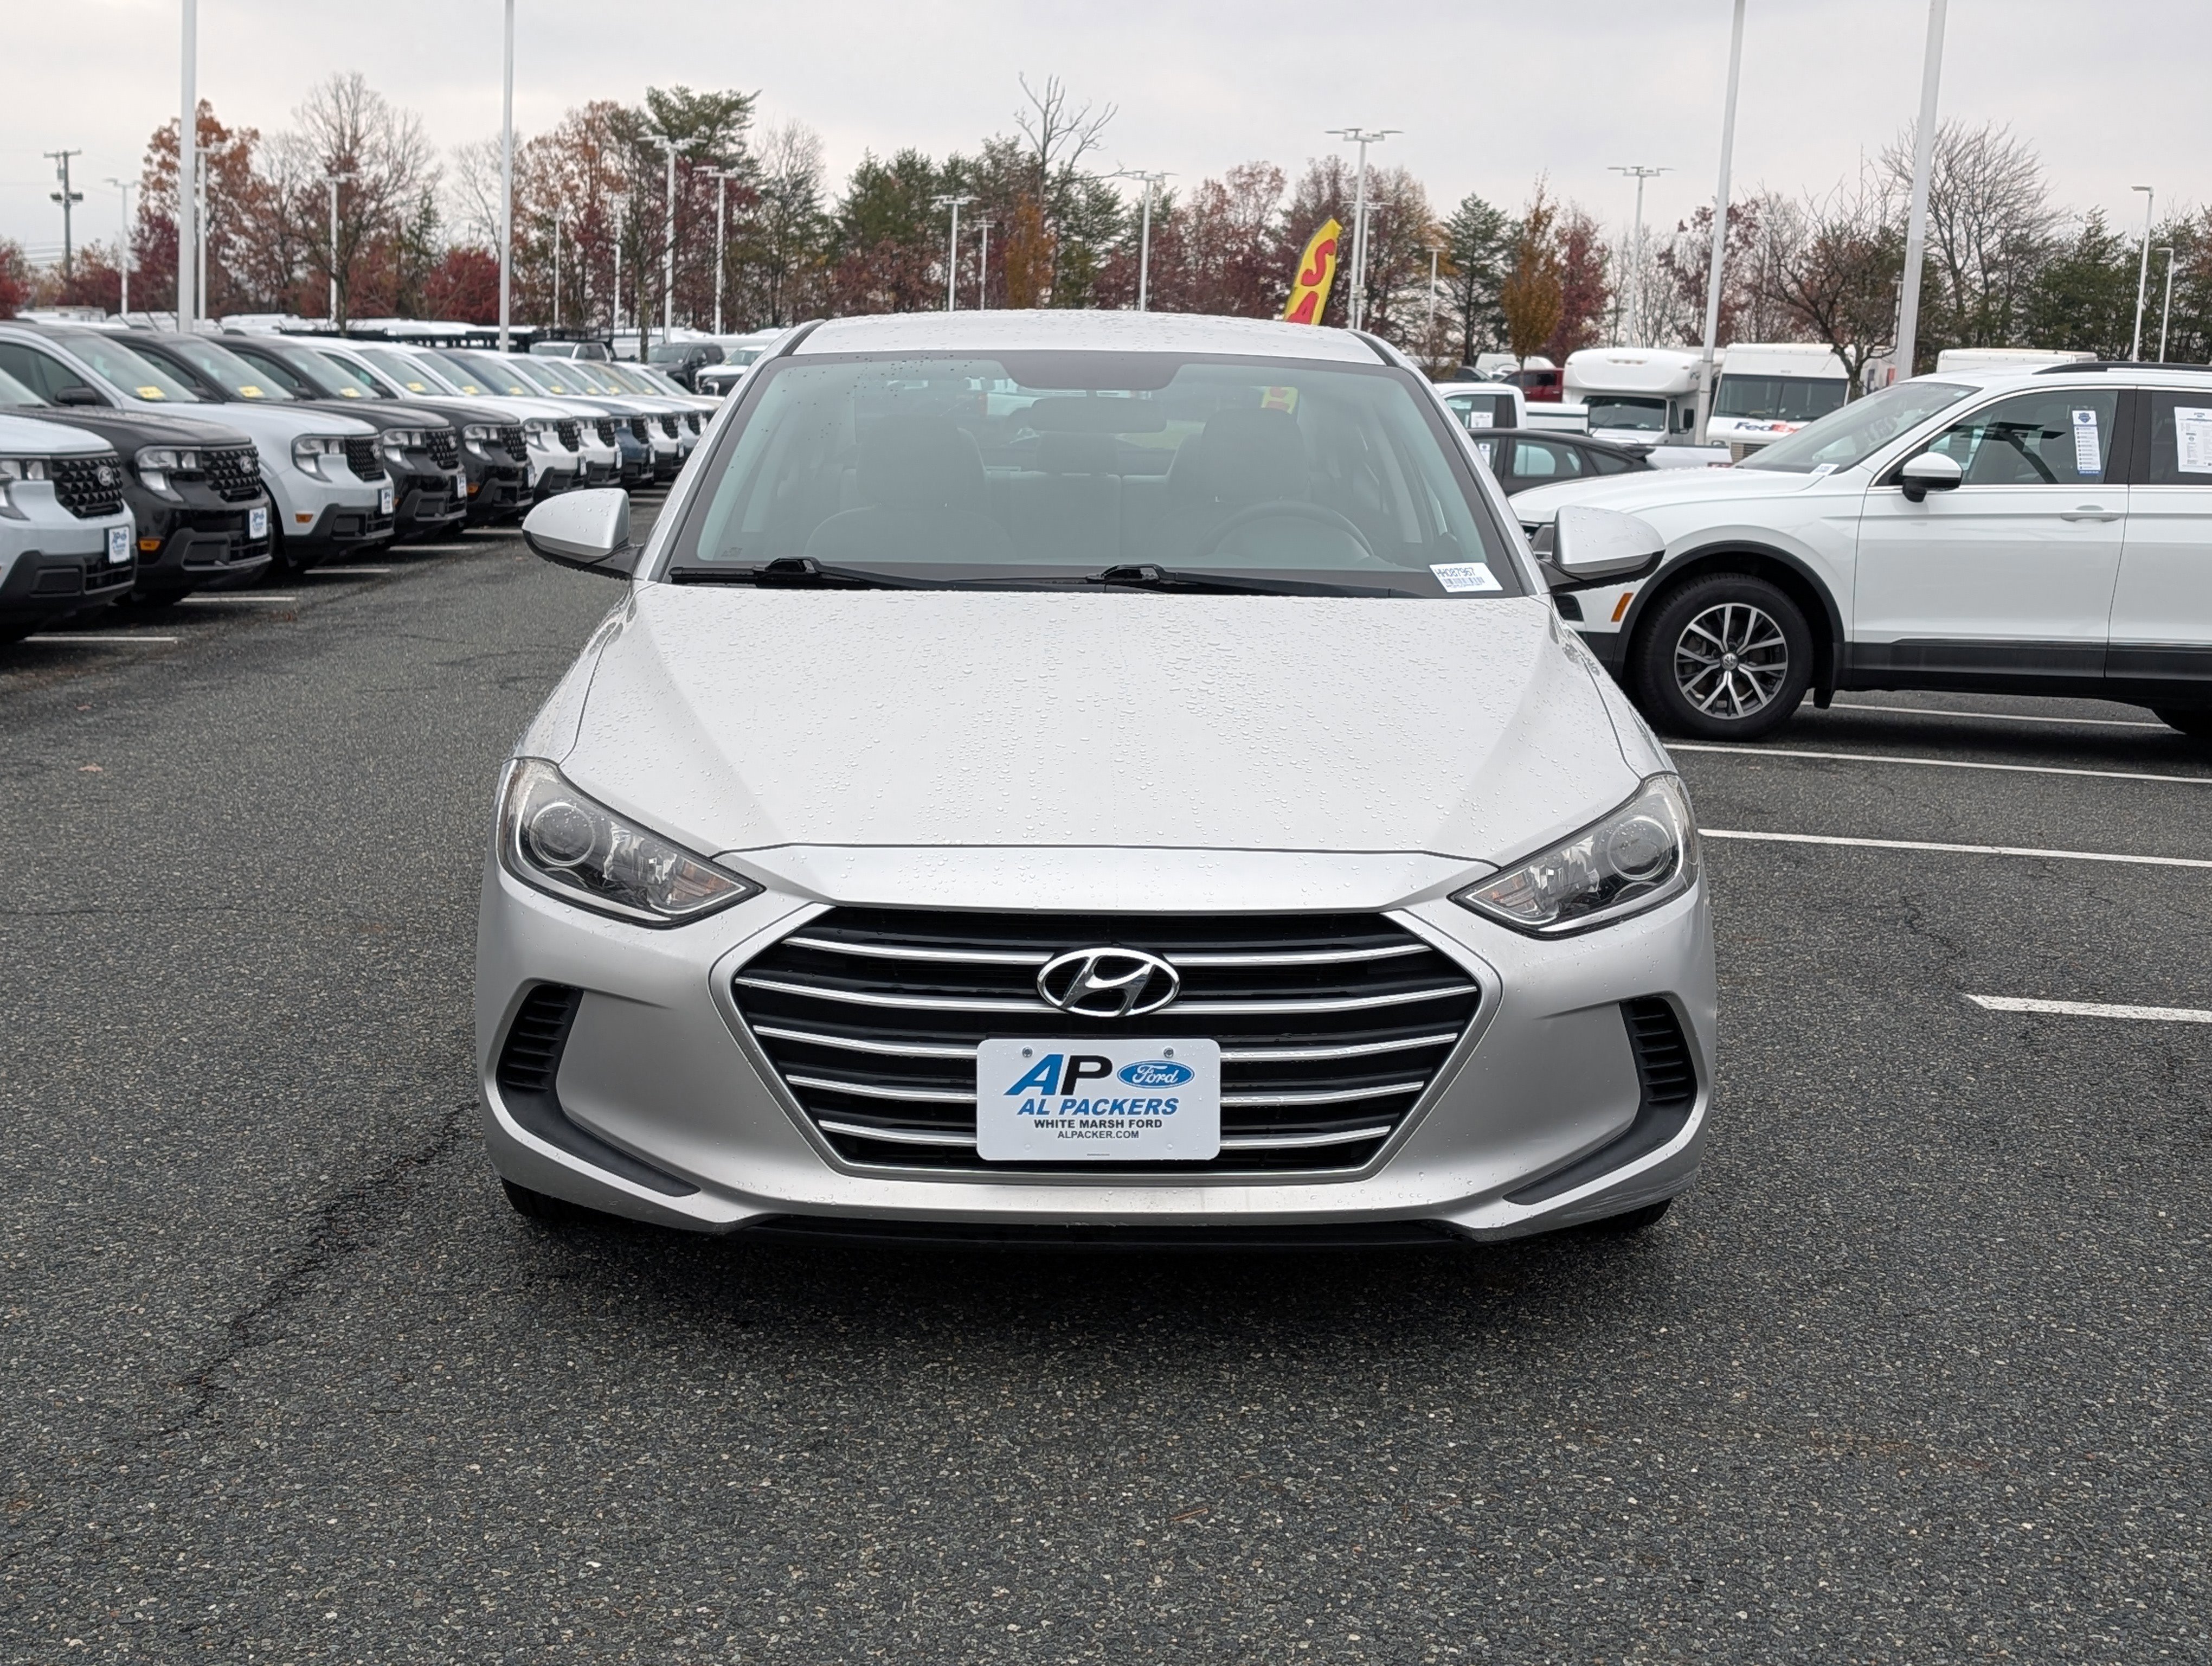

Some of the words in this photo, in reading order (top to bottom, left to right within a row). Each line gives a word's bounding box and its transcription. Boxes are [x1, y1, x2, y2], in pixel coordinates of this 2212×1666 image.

[1003, 1054, 1113, 1096] AP
[1132, 1065, 1180, 1084] Ford
[1017, 1098, 1051, 1116] AL
[1058, 1098, 1179, 1116] PACKERS
[1033, 1119, 1076, 1129] WHITE
[1079, 1119, 1124, 1129] MARSH
[1128, 1119, 1162, 1129] FORD
[1057, 1130, 1139, 1139] ALPACKER.COM
